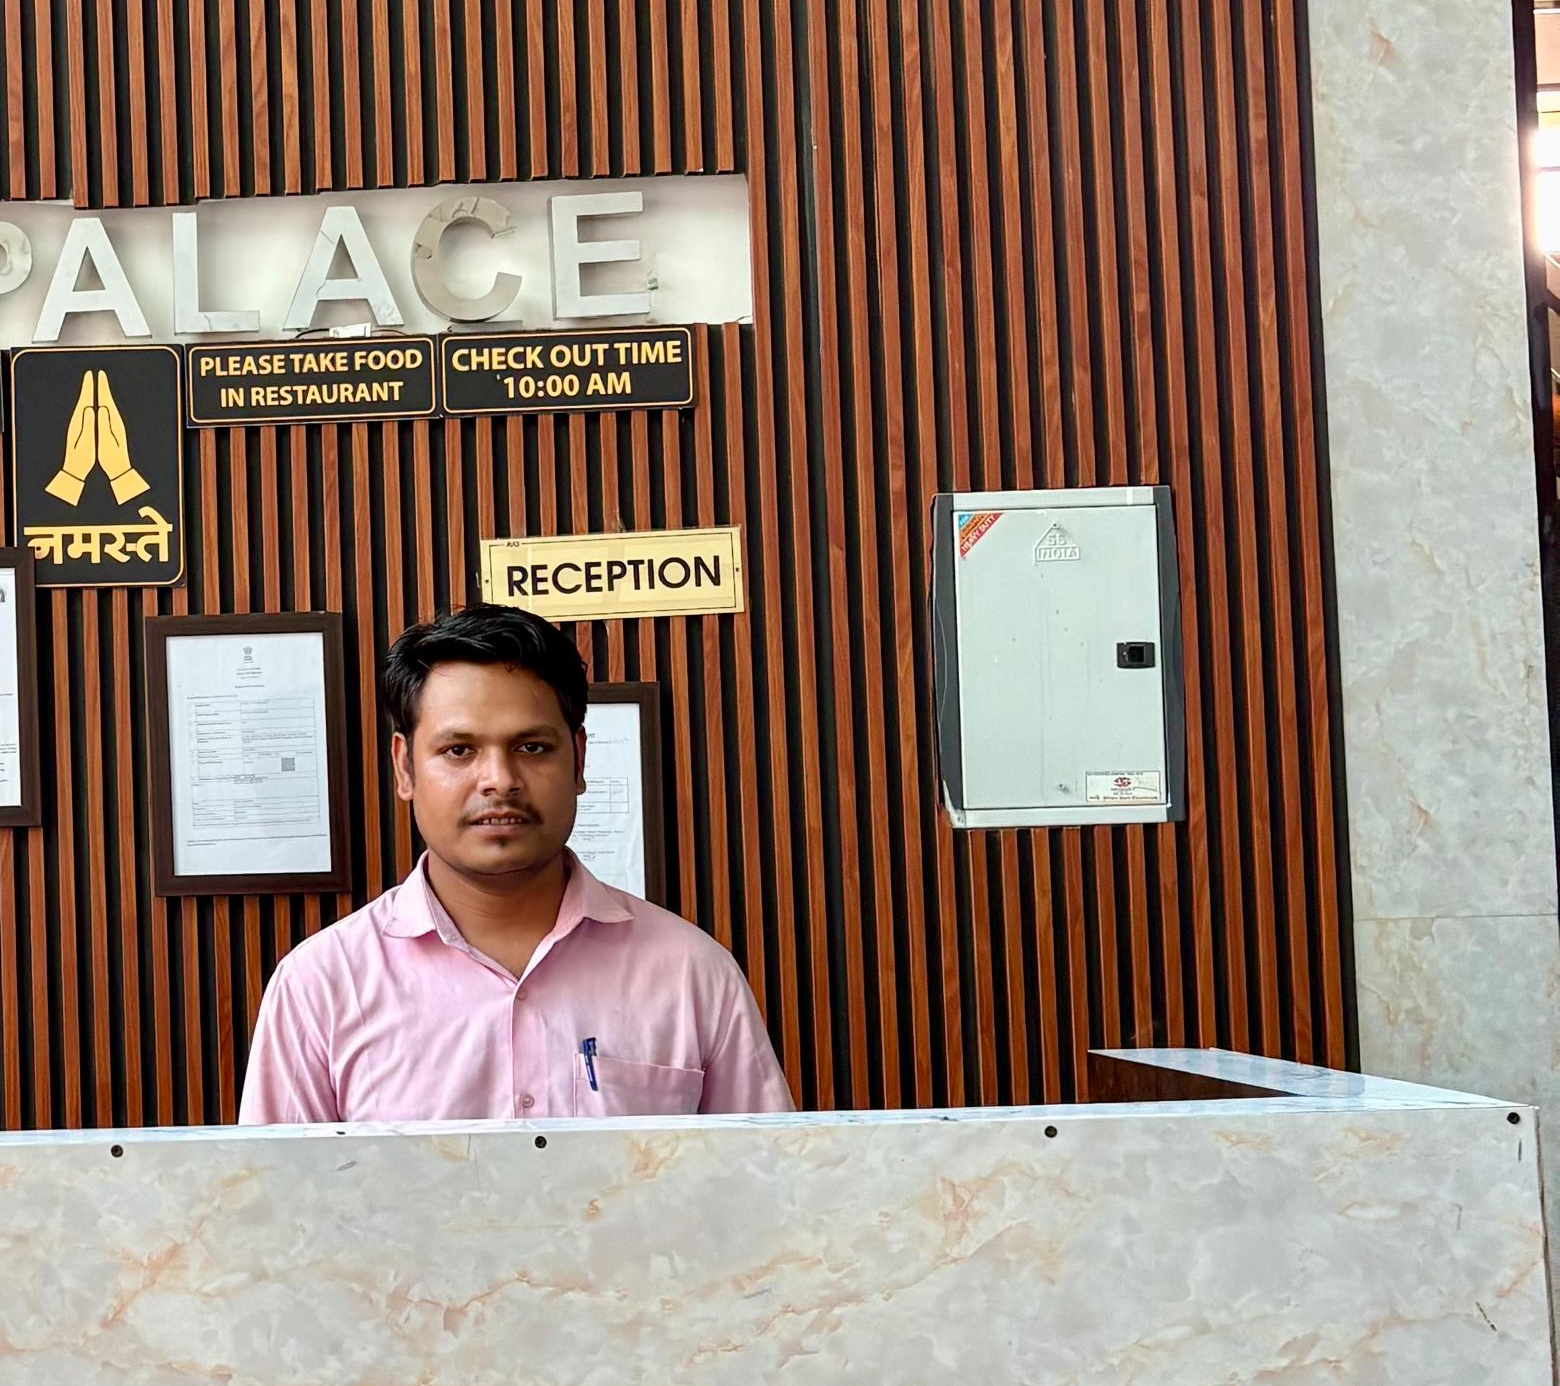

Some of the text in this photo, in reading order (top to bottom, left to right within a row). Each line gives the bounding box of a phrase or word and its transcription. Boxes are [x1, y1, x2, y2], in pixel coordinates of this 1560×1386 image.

[200, 349, 423, 377] PLEASE TAKE FOOD
[451, 340, 682, 372] CHECK OUT TIME
[220, 381, 404, 408] IN RESTAURANT
[503, 371, 632, 398] 10:00 AM
[23, 506, 173, 564] नमस्ते
[506, 555, 722, 597] RECEPTION
